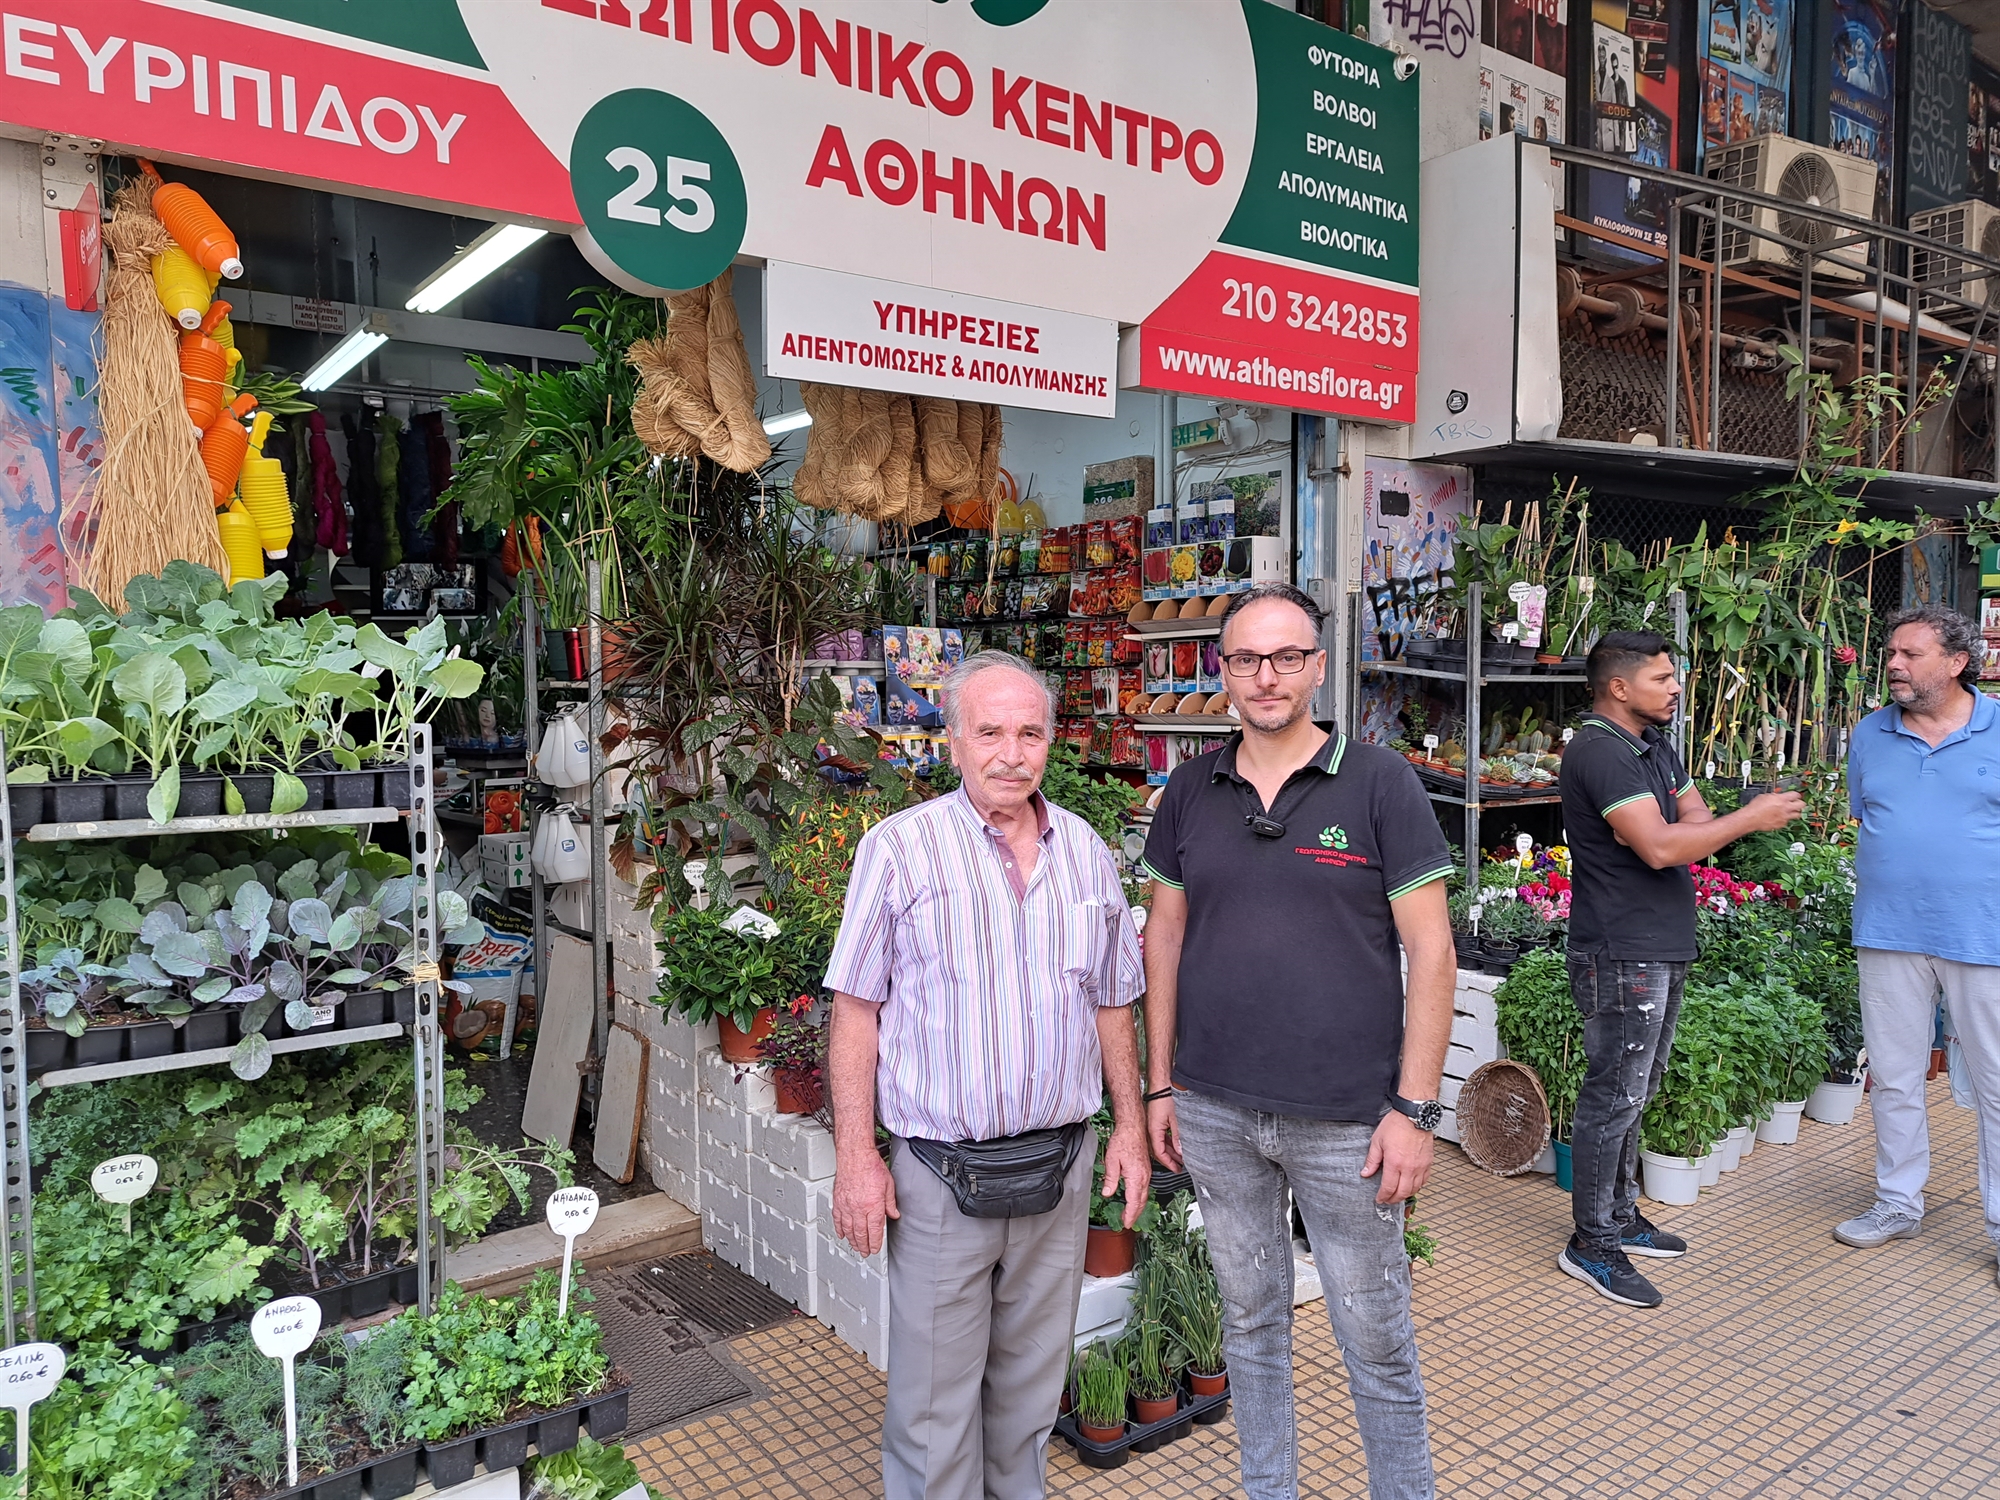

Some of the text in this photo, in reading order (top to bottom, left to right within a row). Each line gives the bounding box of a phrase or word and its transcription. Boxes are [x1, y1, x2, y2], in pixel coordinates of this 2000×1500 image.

[1308, 45, 1381, 89] ΦΥΤΩΡΙΑ
[3, 12, 467, 164] ΕΥΡΙΠΙΔΟΥ
[541, 0, 1224, 186] ΠΟΝΙΚΟ ΚΕΝΤΡΟ
[1313, 90, 1376, 130] ΒΟΛΒΟΙ
[1607, 105, 1631, 117] CODE
[1306, 132, 1384, 175] ΕΡΓΑΛΕΙΑ
[605, 146, 715, 233] 25
[805, 125, 1106, 251] ΑΘΗΝΩΝ
[1278, 170, 1408, 224] ΑΠΟΛΥΜΑΝΤΙΚΑ
[1301, 220, 1388, 260] ΒΙΟΛΟΓΙΚΑ
[1593, 215, 1644, 240] ΚΥΚΛΟΦΟΡΟΥΝ
[1643, 231, 1653, 242] ΣΕ
[873, 300, 1040, 354] ΥΠΗΡΕΣΙΕΣ
[1222, 278, 1407, 348] 210 3242853
[781, 332, 1107, 398] ΑΠΕΝΤΟΜΩΣΗΣ & ΑΠΟΛΥΜΑΝΣΗΣ
[1158, 346, 1403, 410] www.athensflora.gr
[1294, 847, 1339, 858] ΓΕΩΠΟΝΙΚΟ
[1314, 856, 1347, 867] ΑΘΗΝΩΝ
[100, 1159, 143, 1175] ΣΕΛΕΡΥ
[136, 1170, 145, 1181] €
[583, 1206, 590, 1216] €
[293, 1319, 304, 1330] €
[36, 1364, 49, 1378] €
